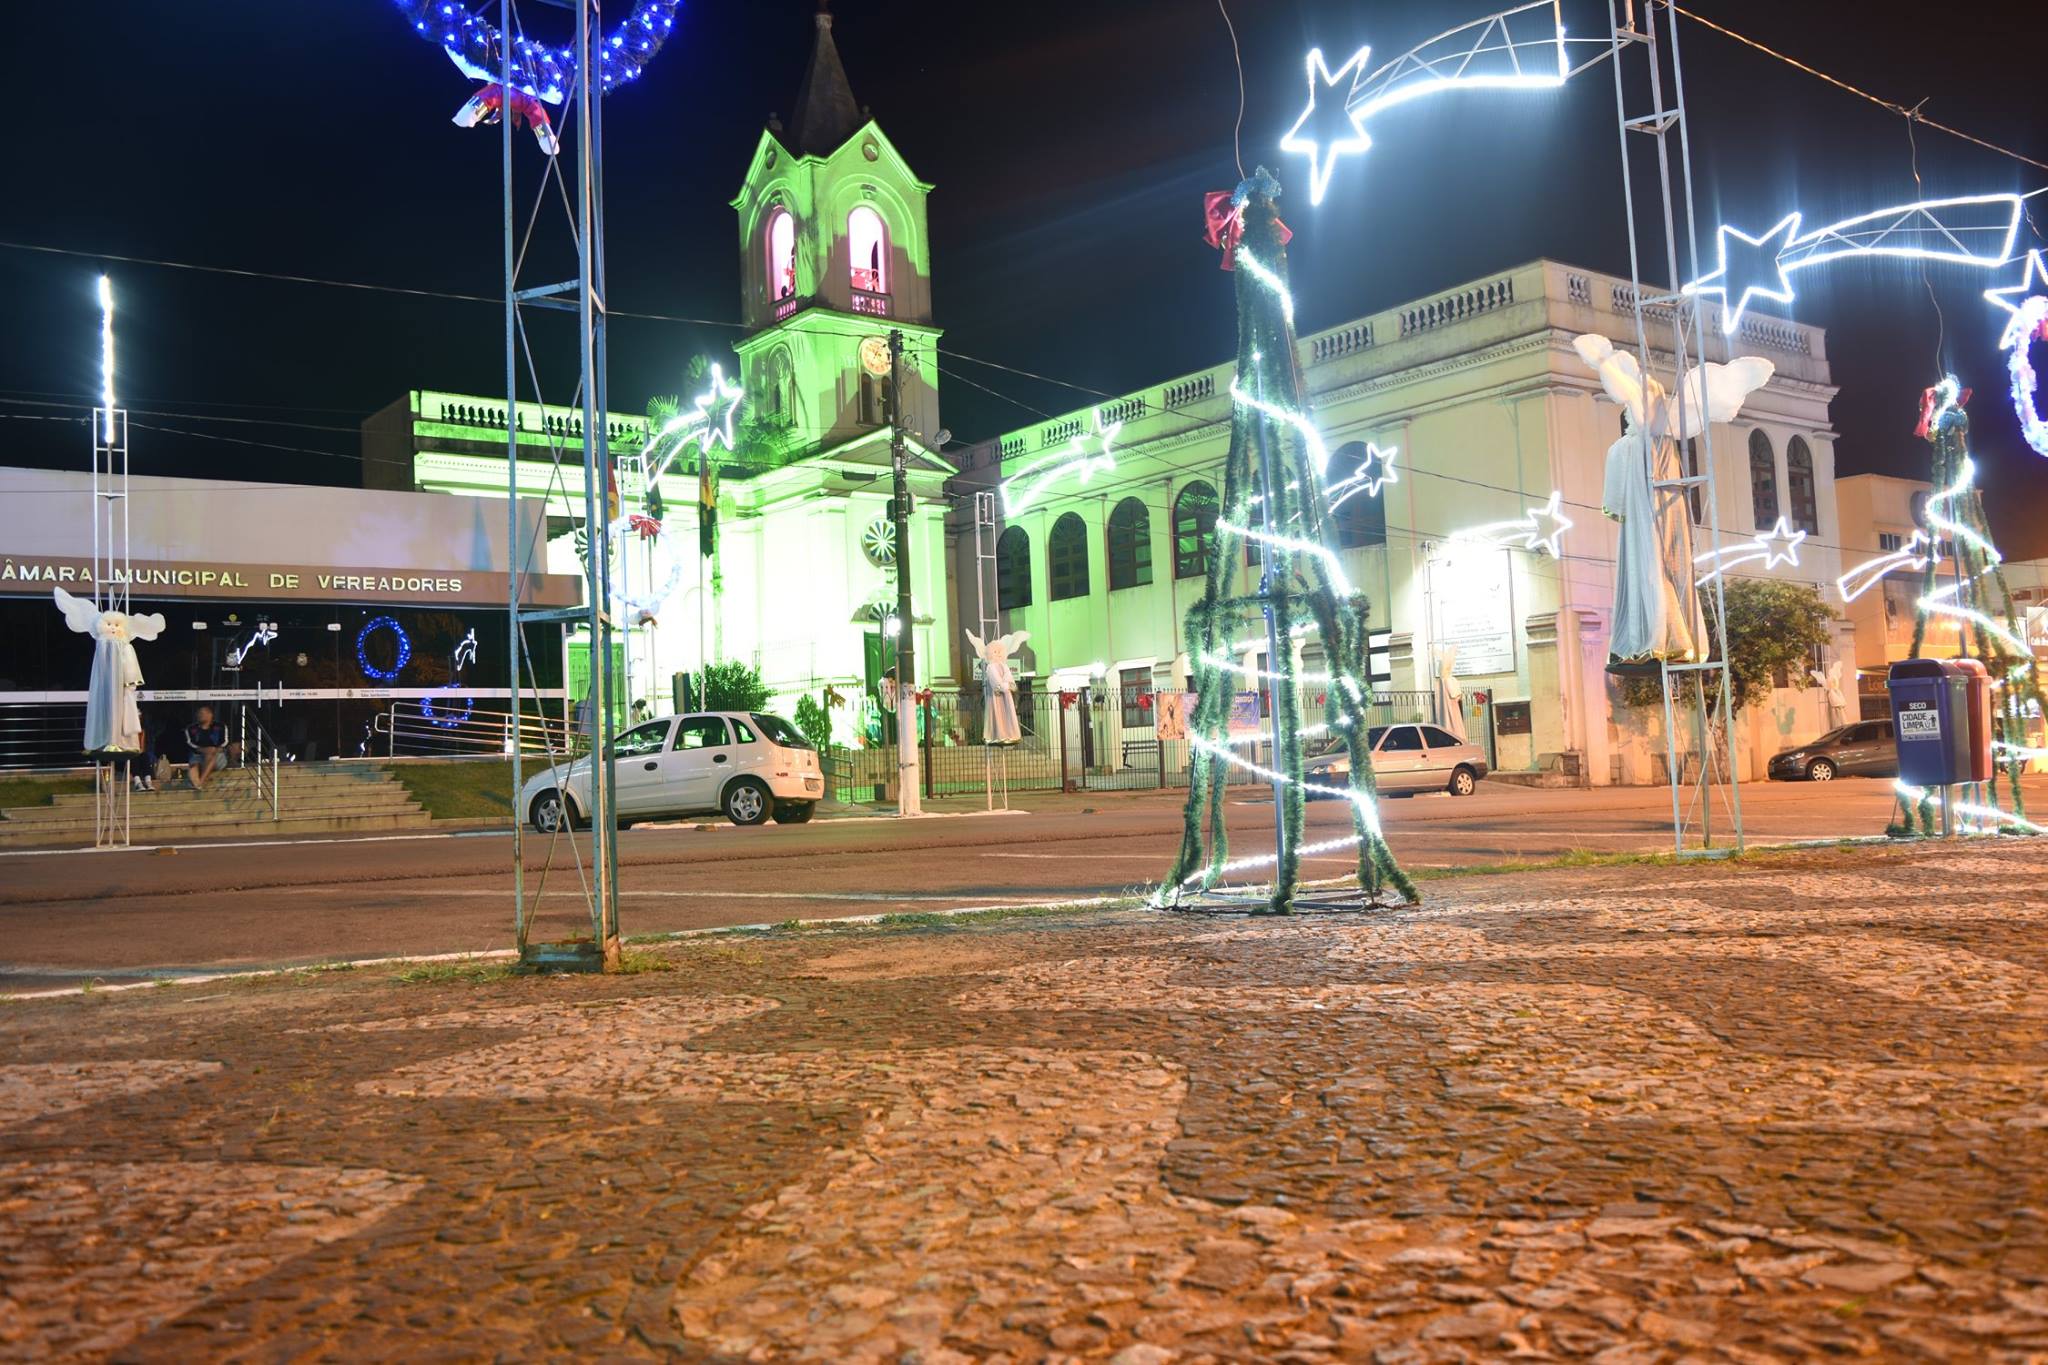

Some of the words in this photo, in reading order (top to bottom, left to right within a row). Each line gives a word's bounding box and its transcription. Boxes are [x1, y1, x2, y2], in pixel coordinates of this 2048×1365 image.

[114, 568, 248, 587] MUNICIPAL
[269, 573, 299, 589] DE
[317, 575, 463, 592] VEREADORES
[1902, 713, 1927, 721] CIDADE
[1902, 721, 1924, 729] LIMPA
